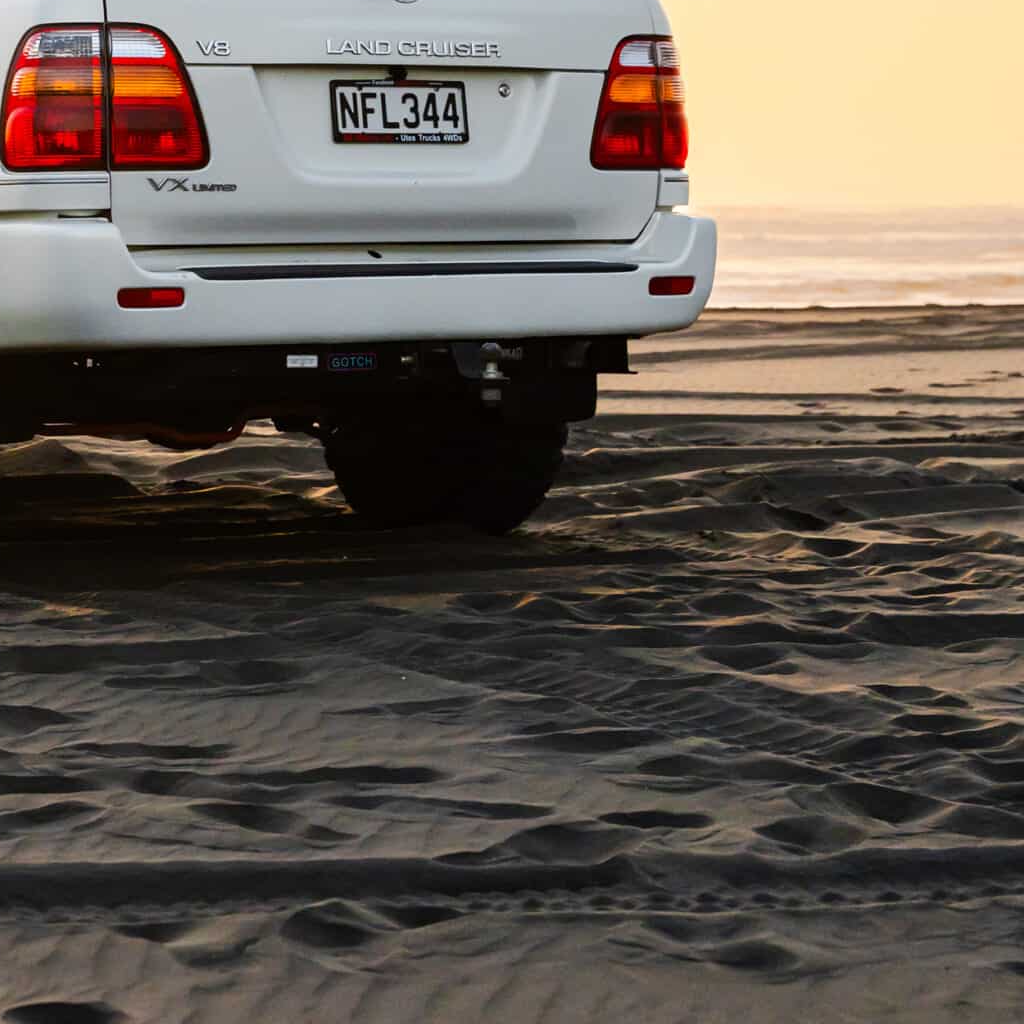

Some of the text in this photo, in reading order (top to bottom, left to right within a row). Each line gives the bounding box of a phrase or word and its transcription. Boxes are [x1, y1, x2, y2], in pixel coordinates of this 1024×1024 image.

[194, 40, 231, 56] V8
[326, 39, 502, 58] LAND CRUISER
[339, 92, 460, 129] NFL344
[417, 134, 441, 142] Trucks
[146, 177, 238, 192] VX LIMITED
